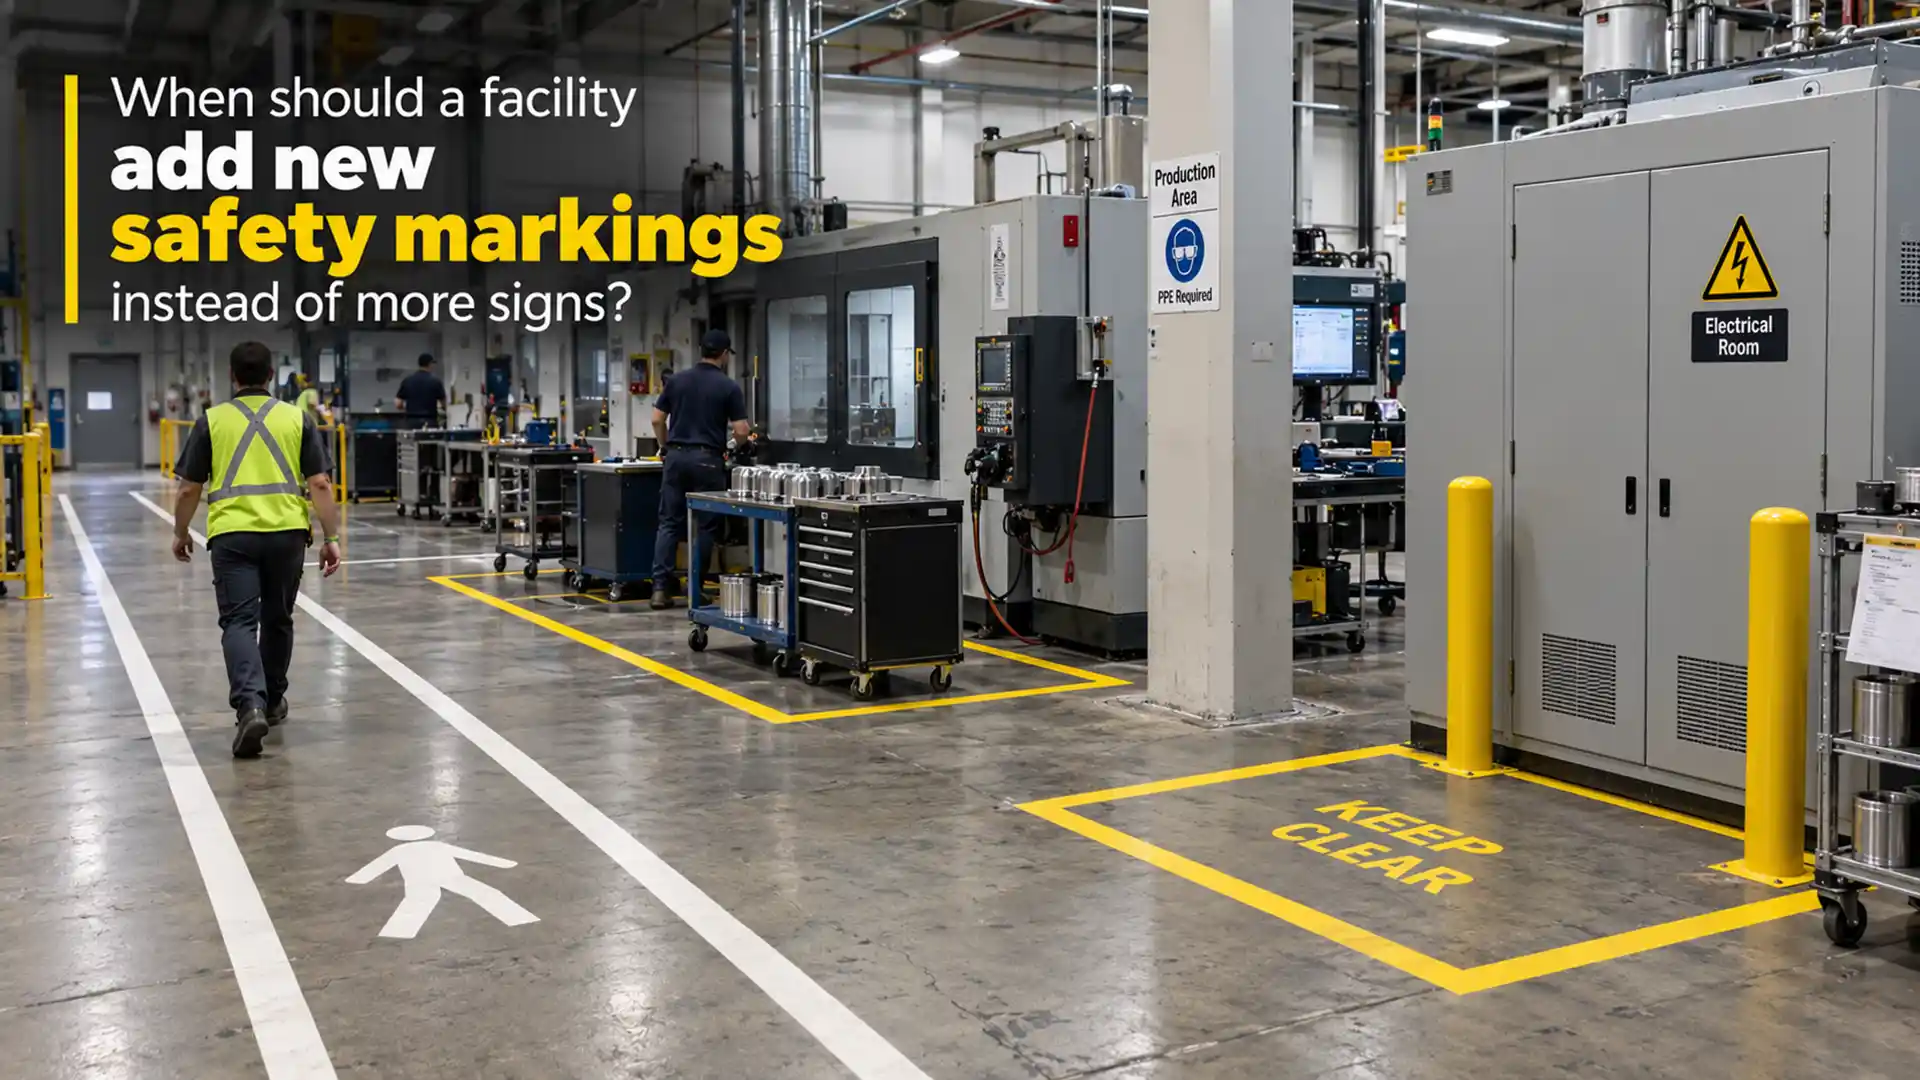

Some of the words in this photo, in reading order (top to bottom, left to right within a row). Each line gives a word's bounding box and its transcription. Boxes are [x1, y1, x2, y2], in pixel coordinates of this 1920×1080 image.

[1155, 162, 1216, 187] Production
[1171, 187, 1198, 208] Area
[1158, 289, 1174, 305] PPE
[1175, 287, 1213, 306] Required
[1705, 315, 1773, 334] Electrical
[1718, 338, 1759, 356] Room
[1314, 800, 1503, 854] KEEP
[1272, 823, 1474, 895] CLEAR
